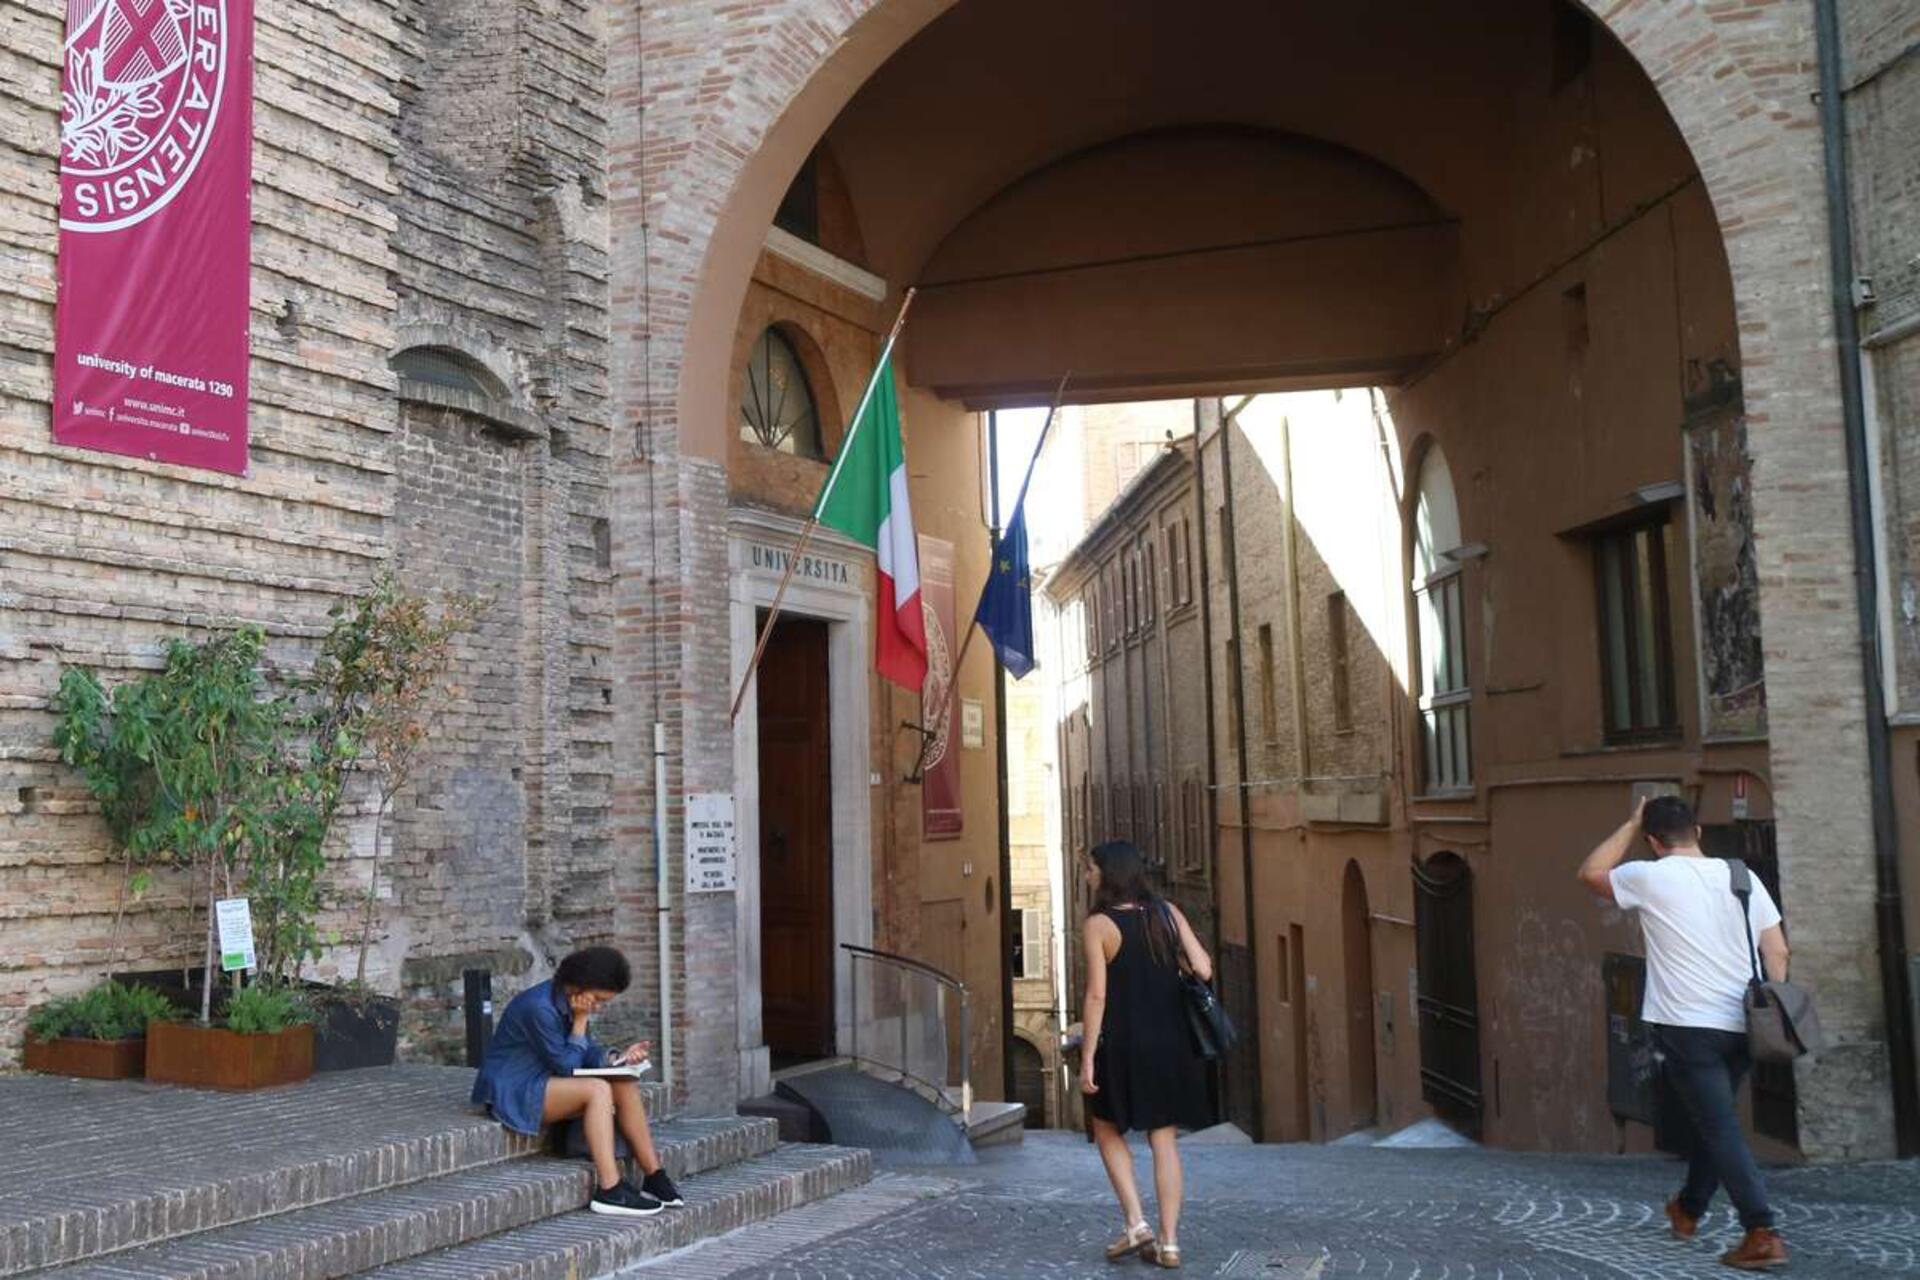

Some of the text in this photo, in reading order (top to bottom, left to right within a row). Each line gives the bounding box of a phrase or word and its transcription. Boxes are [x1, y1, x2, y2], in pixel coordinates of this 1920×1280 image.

[77, 353, 233, 398] university of macerata 1290
